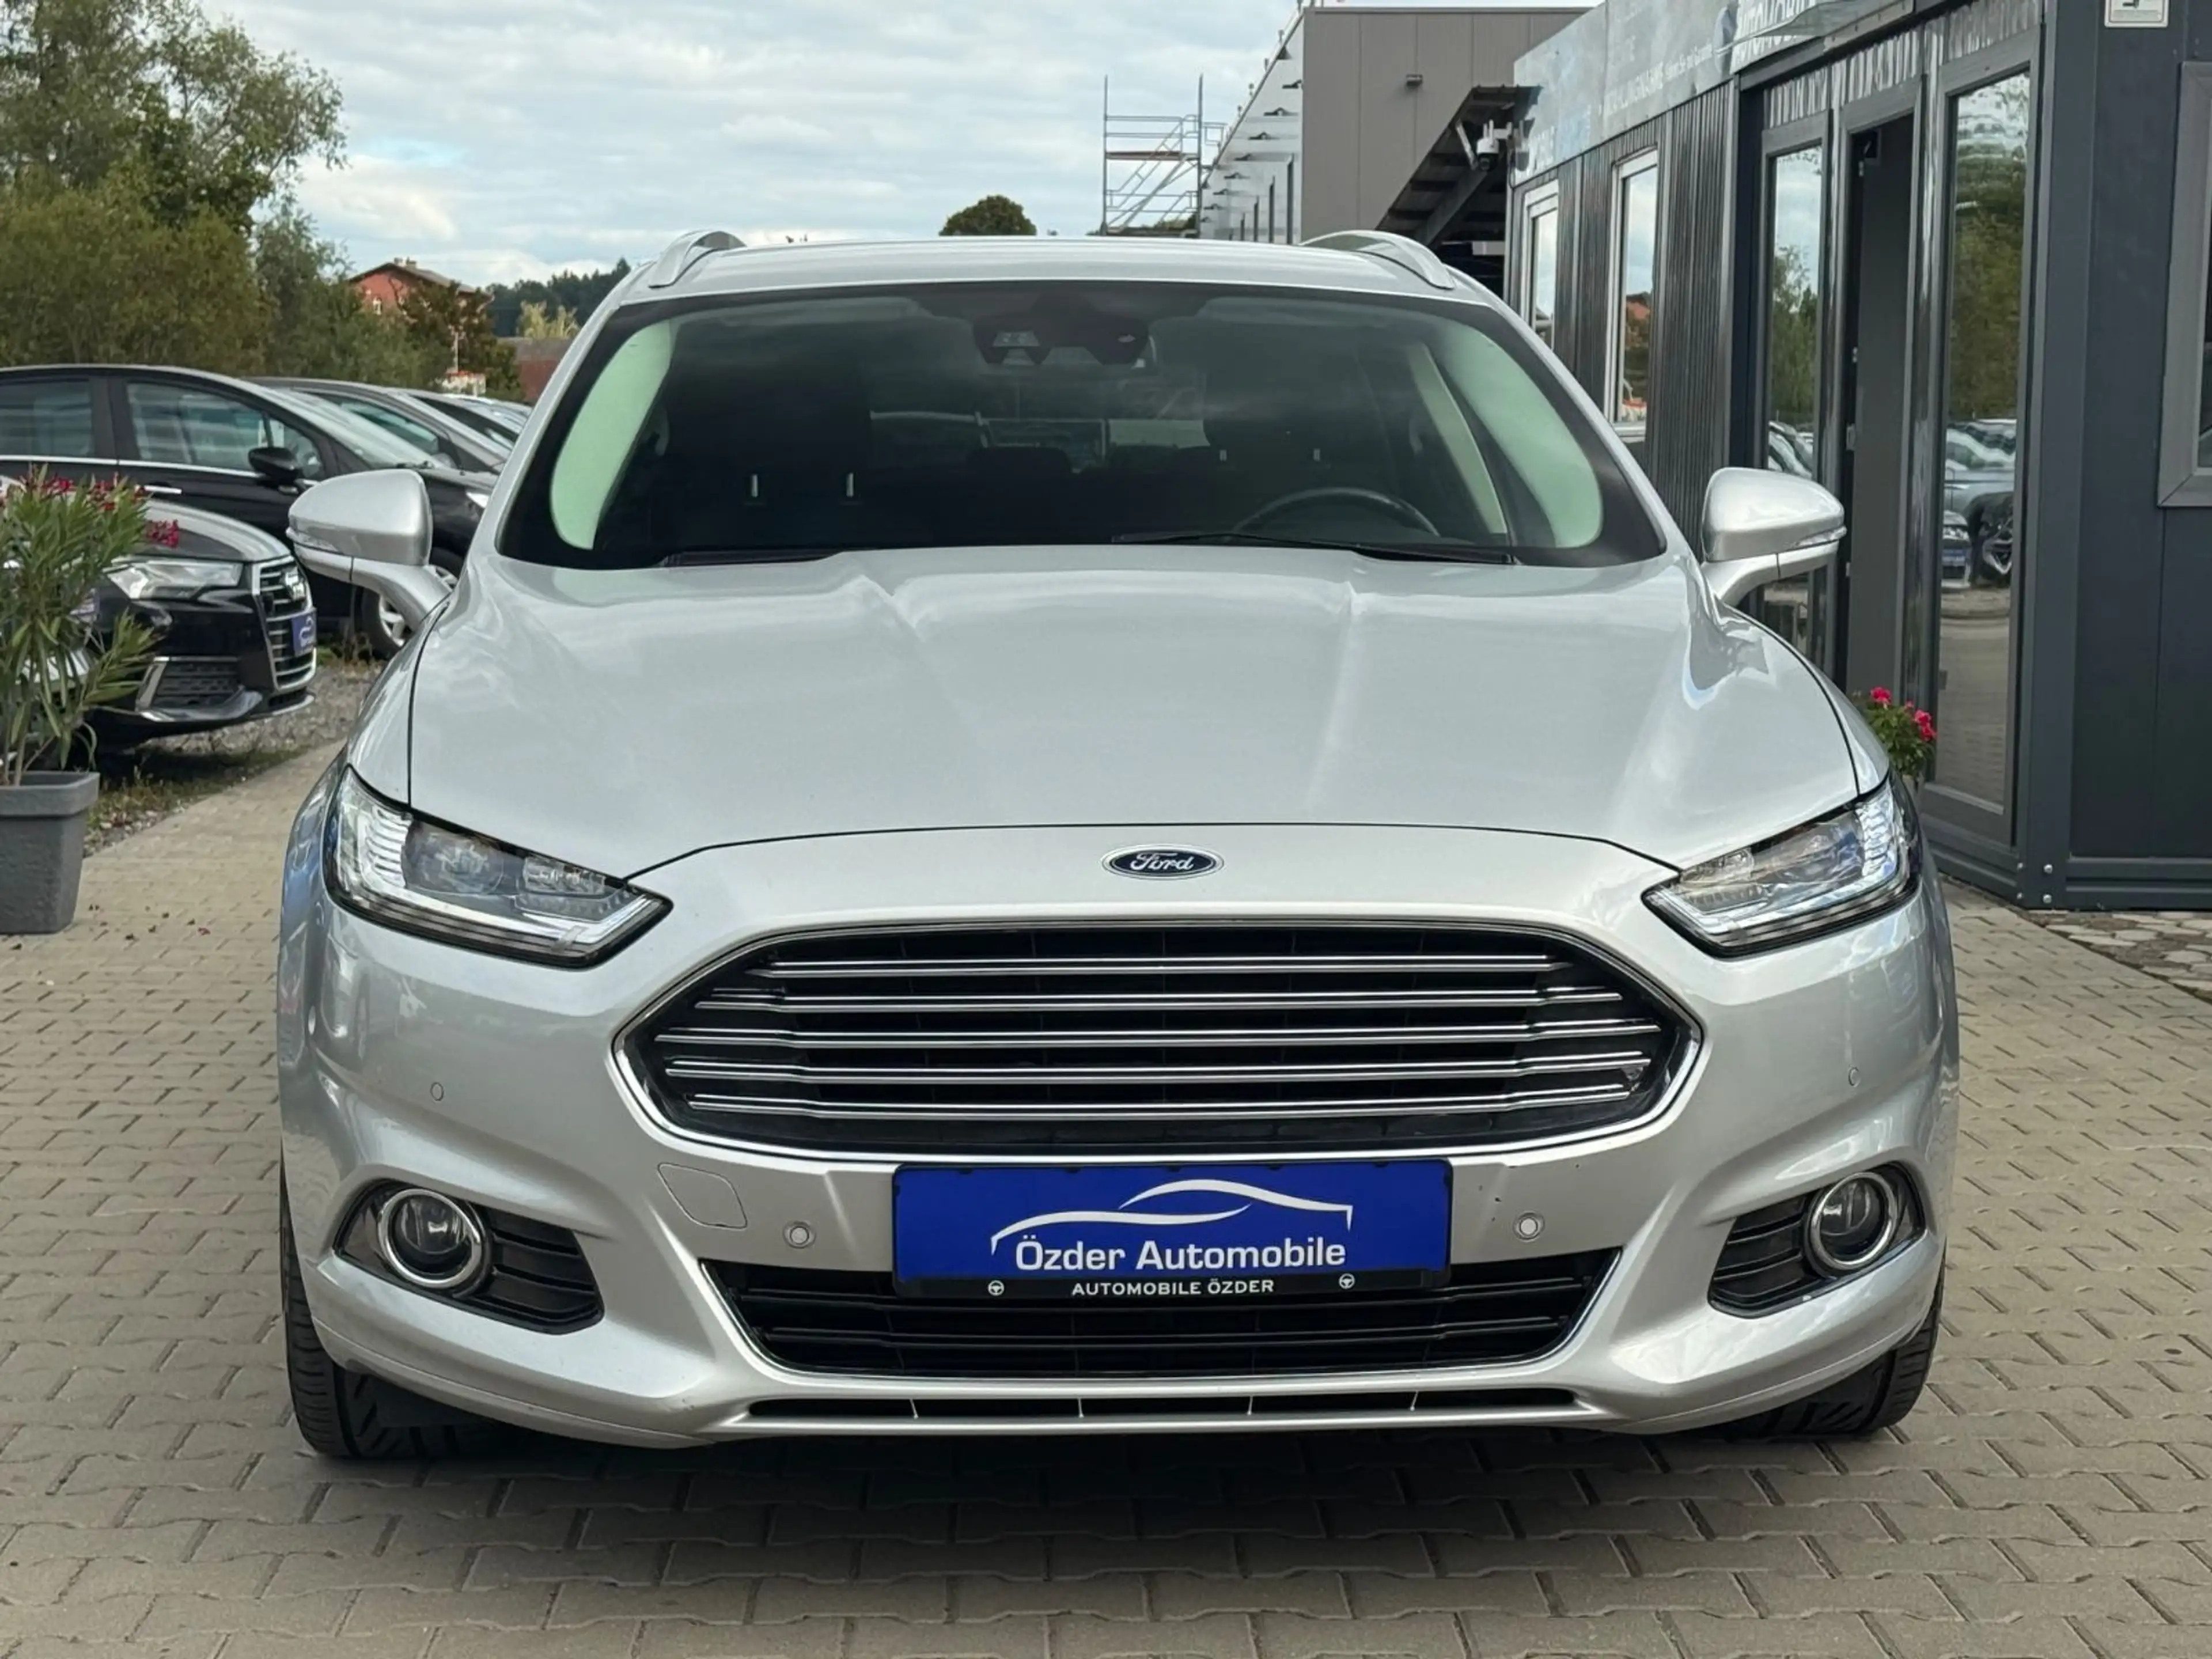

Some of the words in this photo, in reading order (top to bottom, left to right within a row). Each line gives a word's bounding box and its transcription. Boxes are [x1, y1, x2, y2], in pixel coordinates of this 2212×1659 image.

[1130, 852, 1195, 871] Ford
[1016, 1234, 1126, 1270] Özder
[1136, 1236, 1346, 1270] Automobile
[1071, 1281, 1202, 1296] AUTOMOBILE
[1207, 1278, 1274, 1294] ÖZDER
